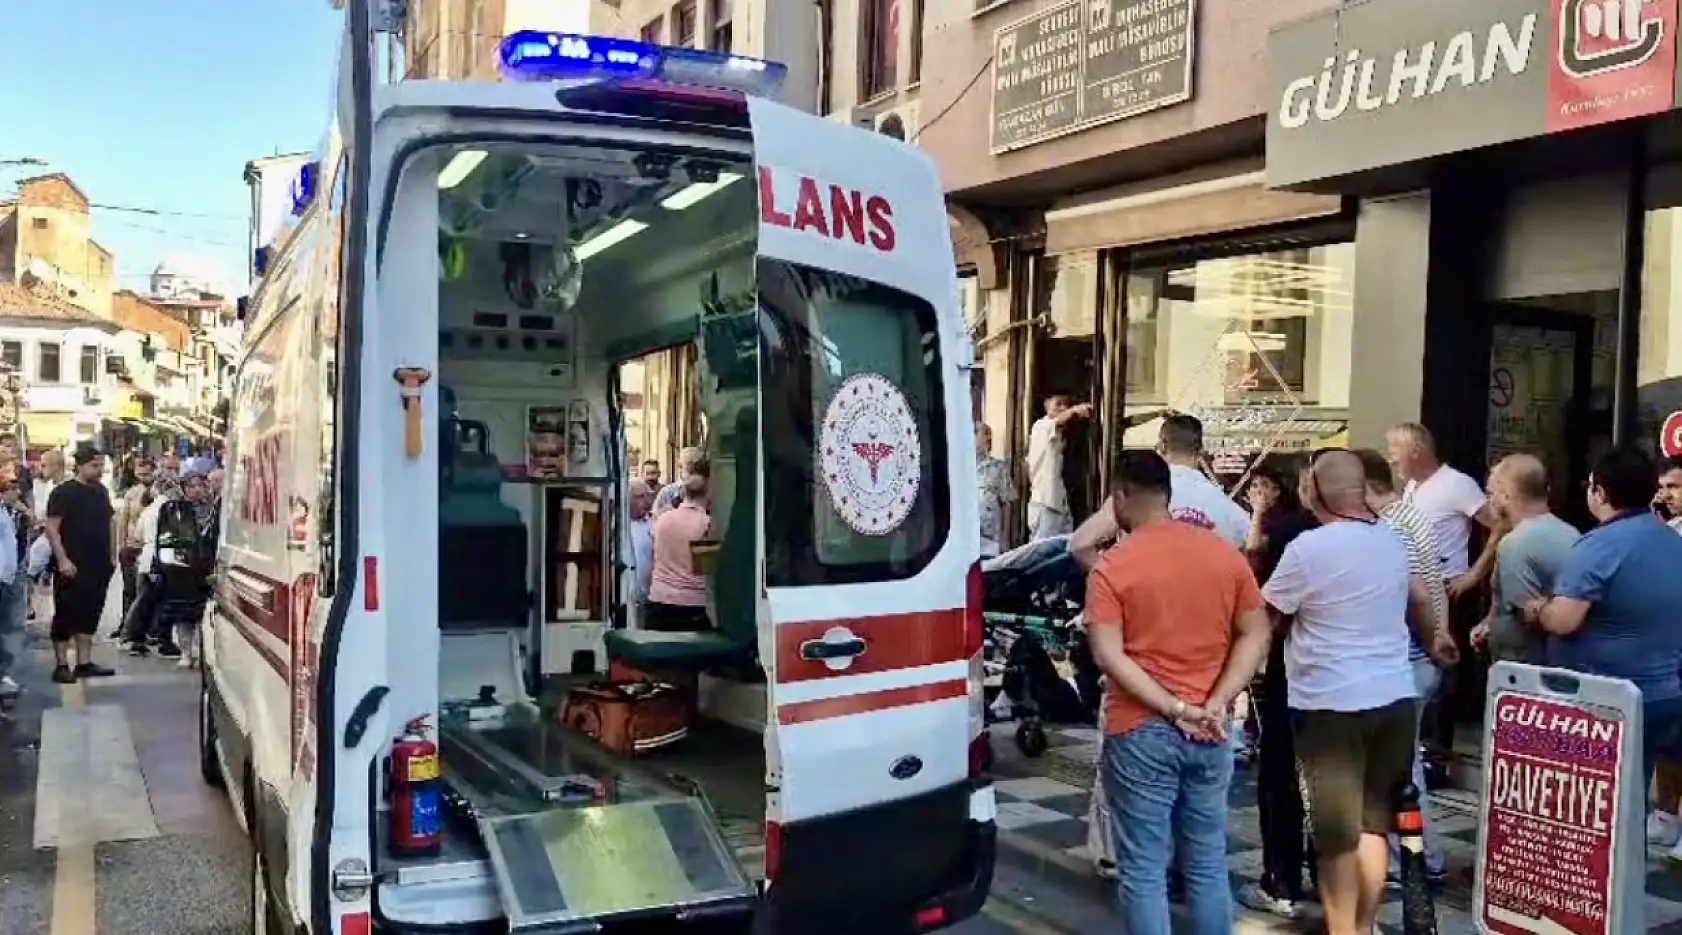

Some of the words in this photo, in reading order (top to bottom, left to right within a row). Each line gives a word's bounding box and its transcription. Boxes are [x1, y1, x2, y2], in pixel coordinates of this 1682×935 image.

[1279, 13, 1537, 128] GÜLHAN
[758, 165, 895, 252] LANS
[1499, 702, 1615, 742] GÜLHAN
[1494, 757, 1610, 830] DAVETİYE
